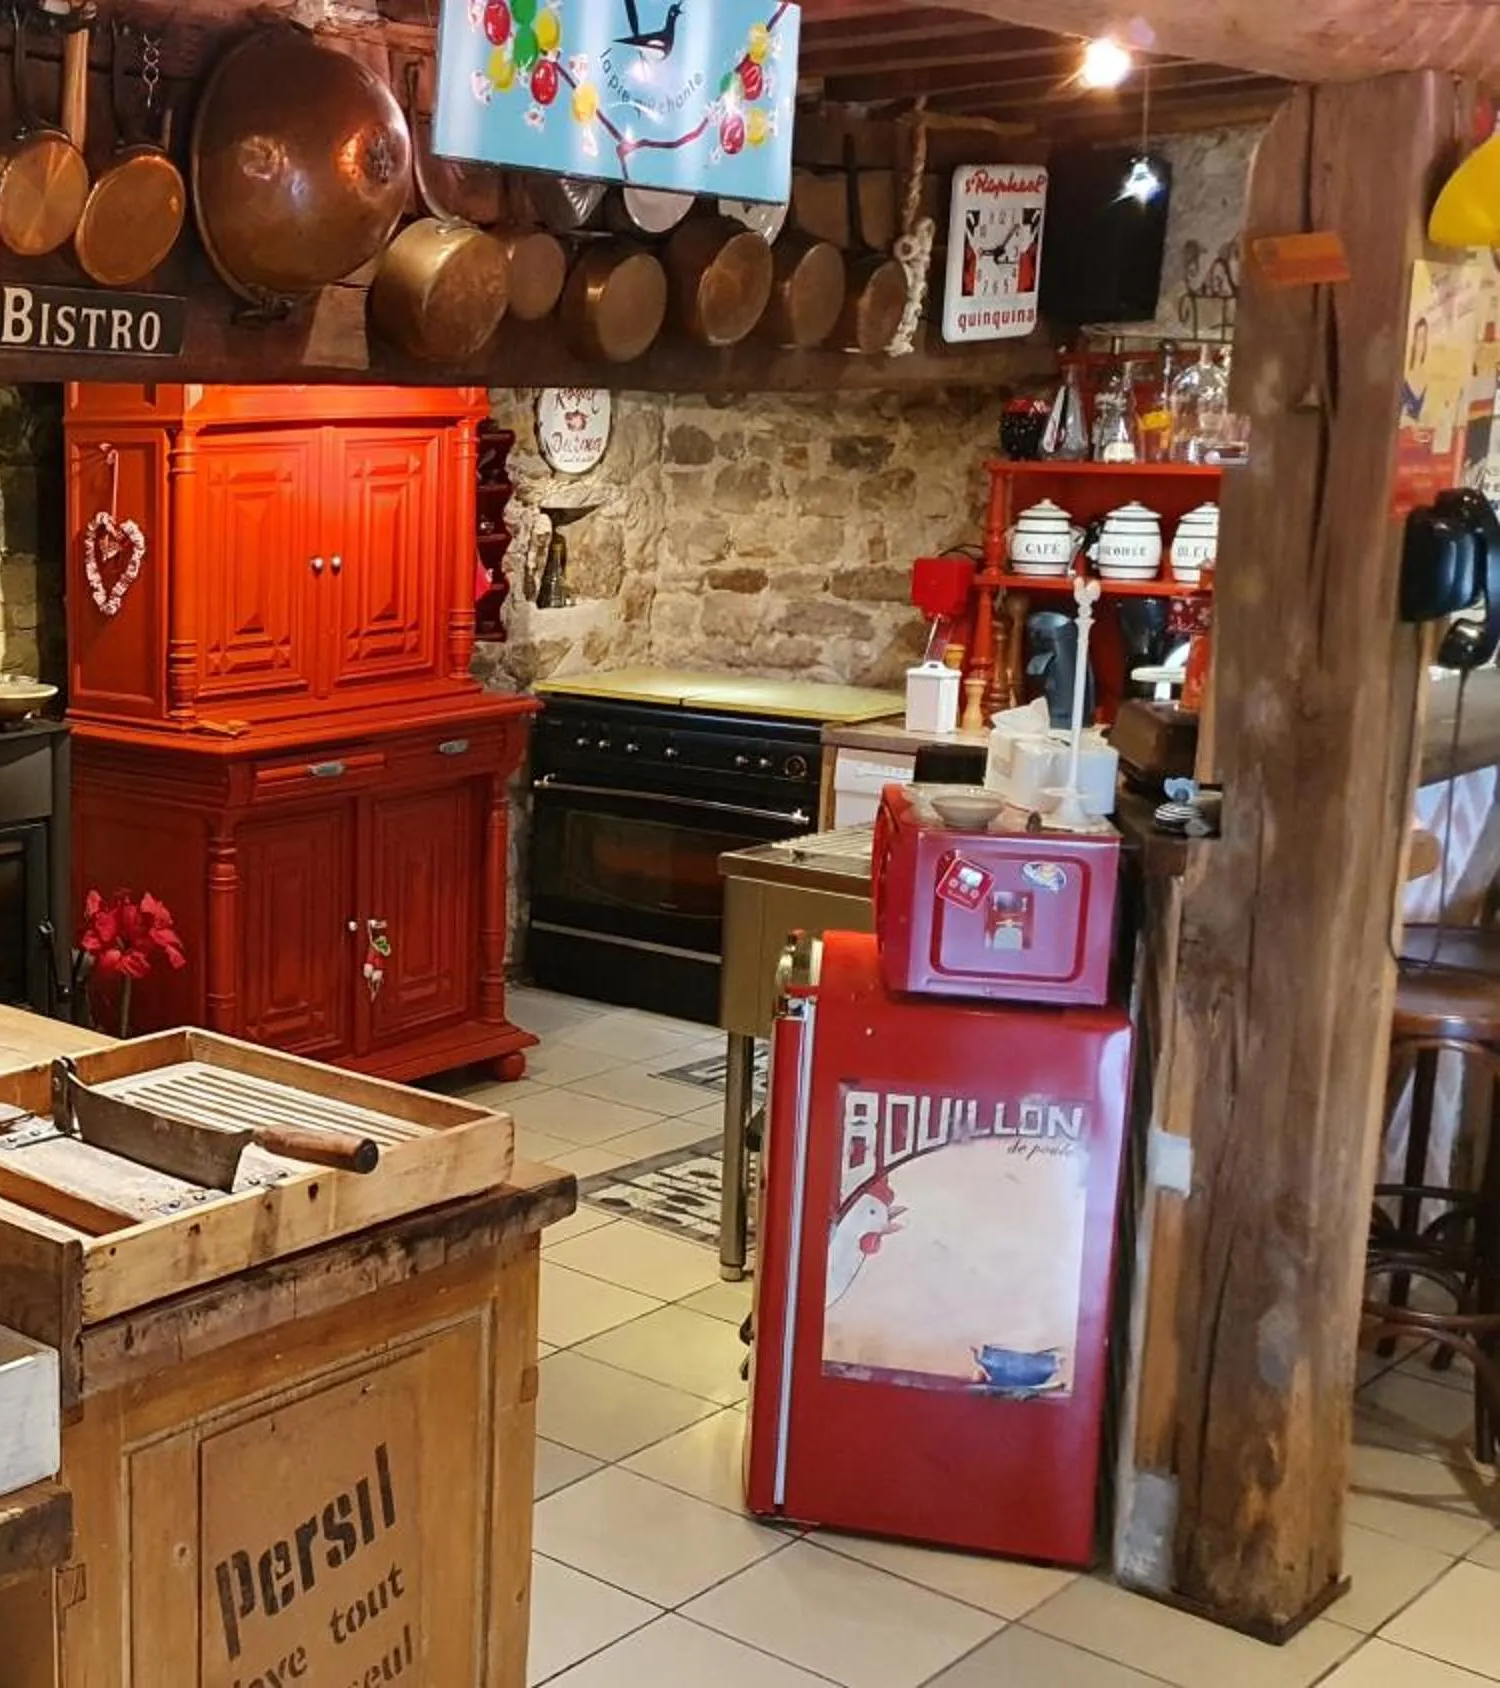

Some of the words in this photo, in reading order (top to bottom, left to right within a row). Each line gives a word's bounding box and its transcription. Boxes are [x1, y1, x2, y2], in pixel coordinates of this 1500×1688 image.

[841, 1091, 1084, 1203] BOUILLON
[1007, 1139, 1027, 1154] de
[329, 1561, 406, 1644] tout
[348, 1624, 413, 1688] eul
